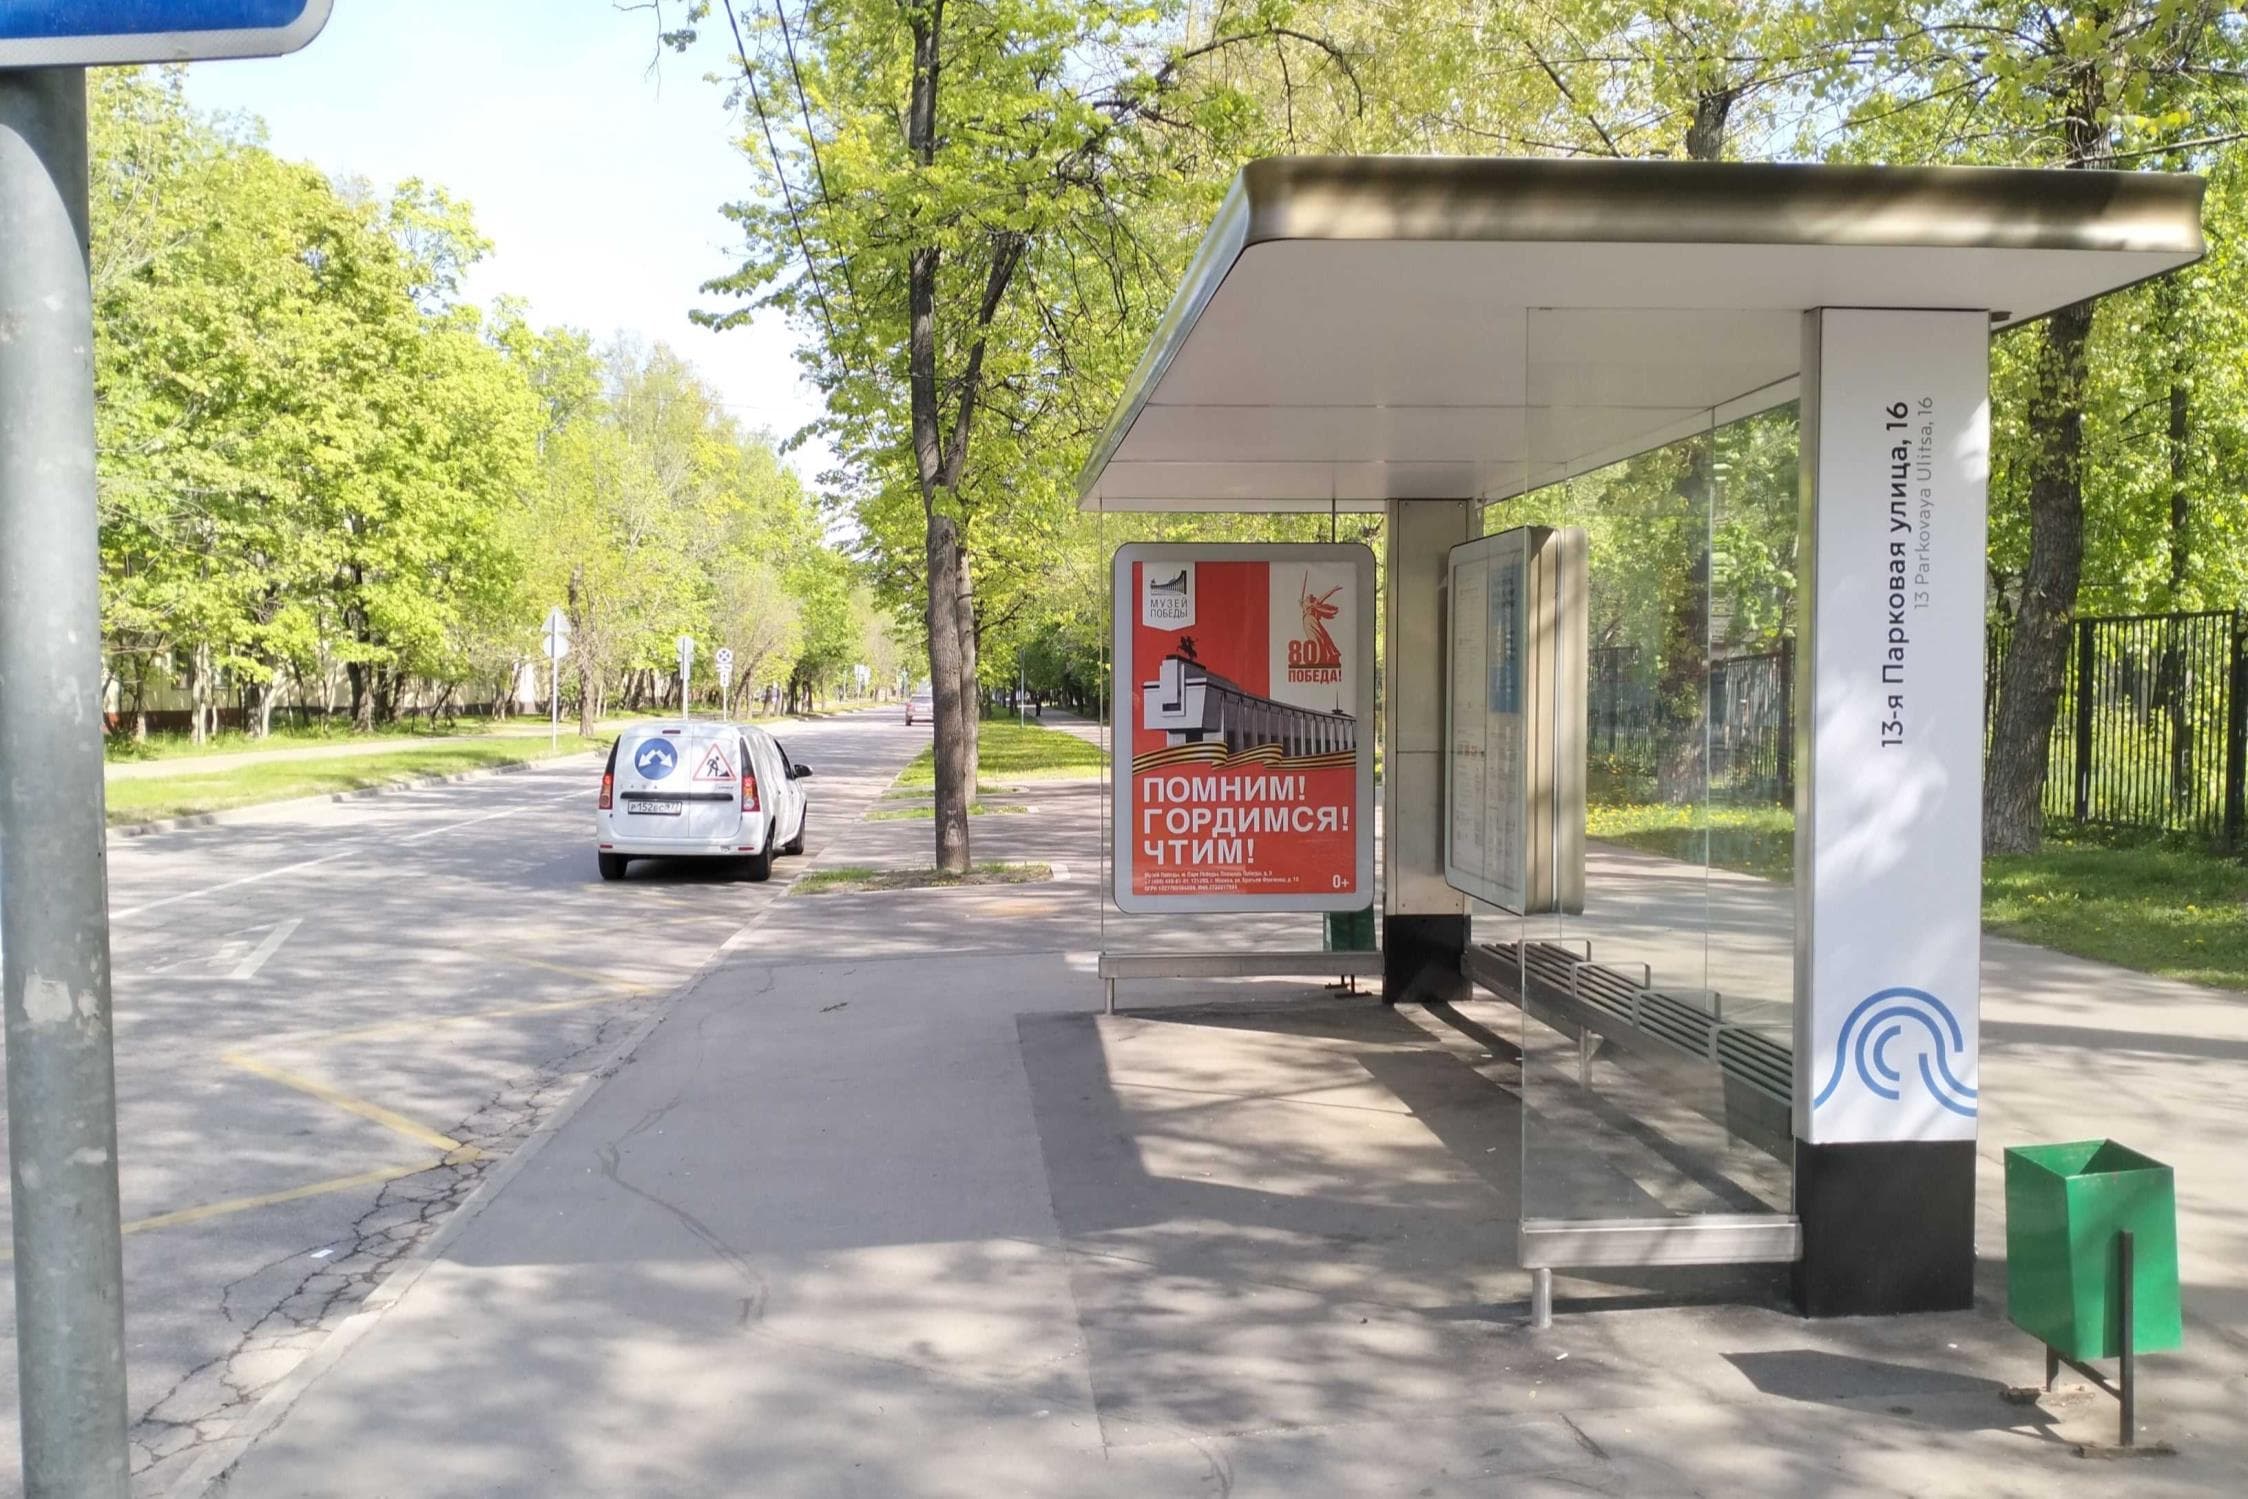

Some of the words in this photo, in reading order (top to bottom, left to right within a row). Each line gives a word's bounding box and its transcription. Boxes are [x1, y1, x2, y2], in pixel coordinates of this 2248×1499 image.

[1886, 401, 1909, 431] 16
[1918, 396, 1933, 416] 16
[1916, 421, 1934, 481] Ulitsa,
[1890, 439, 1913, 533] улица,
[1914, 488, 1935, 585] Parkovaya
[1150, 597, 1188, 608] МУЗЕЙ
[1150, 608, 1188, 619] ПОБЕДЫ
[1882, 542, 1910, 684] Парковая
[1914, 591, 1929, 609] 13
[1288, 639, 1319, 665] 80
[1288, 669, 1342, 685] ПОБЕДА!
[1881, 695, 1904, 748] 13-я
[1143, 775, 1306, 803] ПОМНИМ!
[1143, 805, 1349, 838] ГОРДИМСЯ!
[1143, 838, 1255, 865] ЧТИМ!
[1333, 874, 1350, 889] 0+
